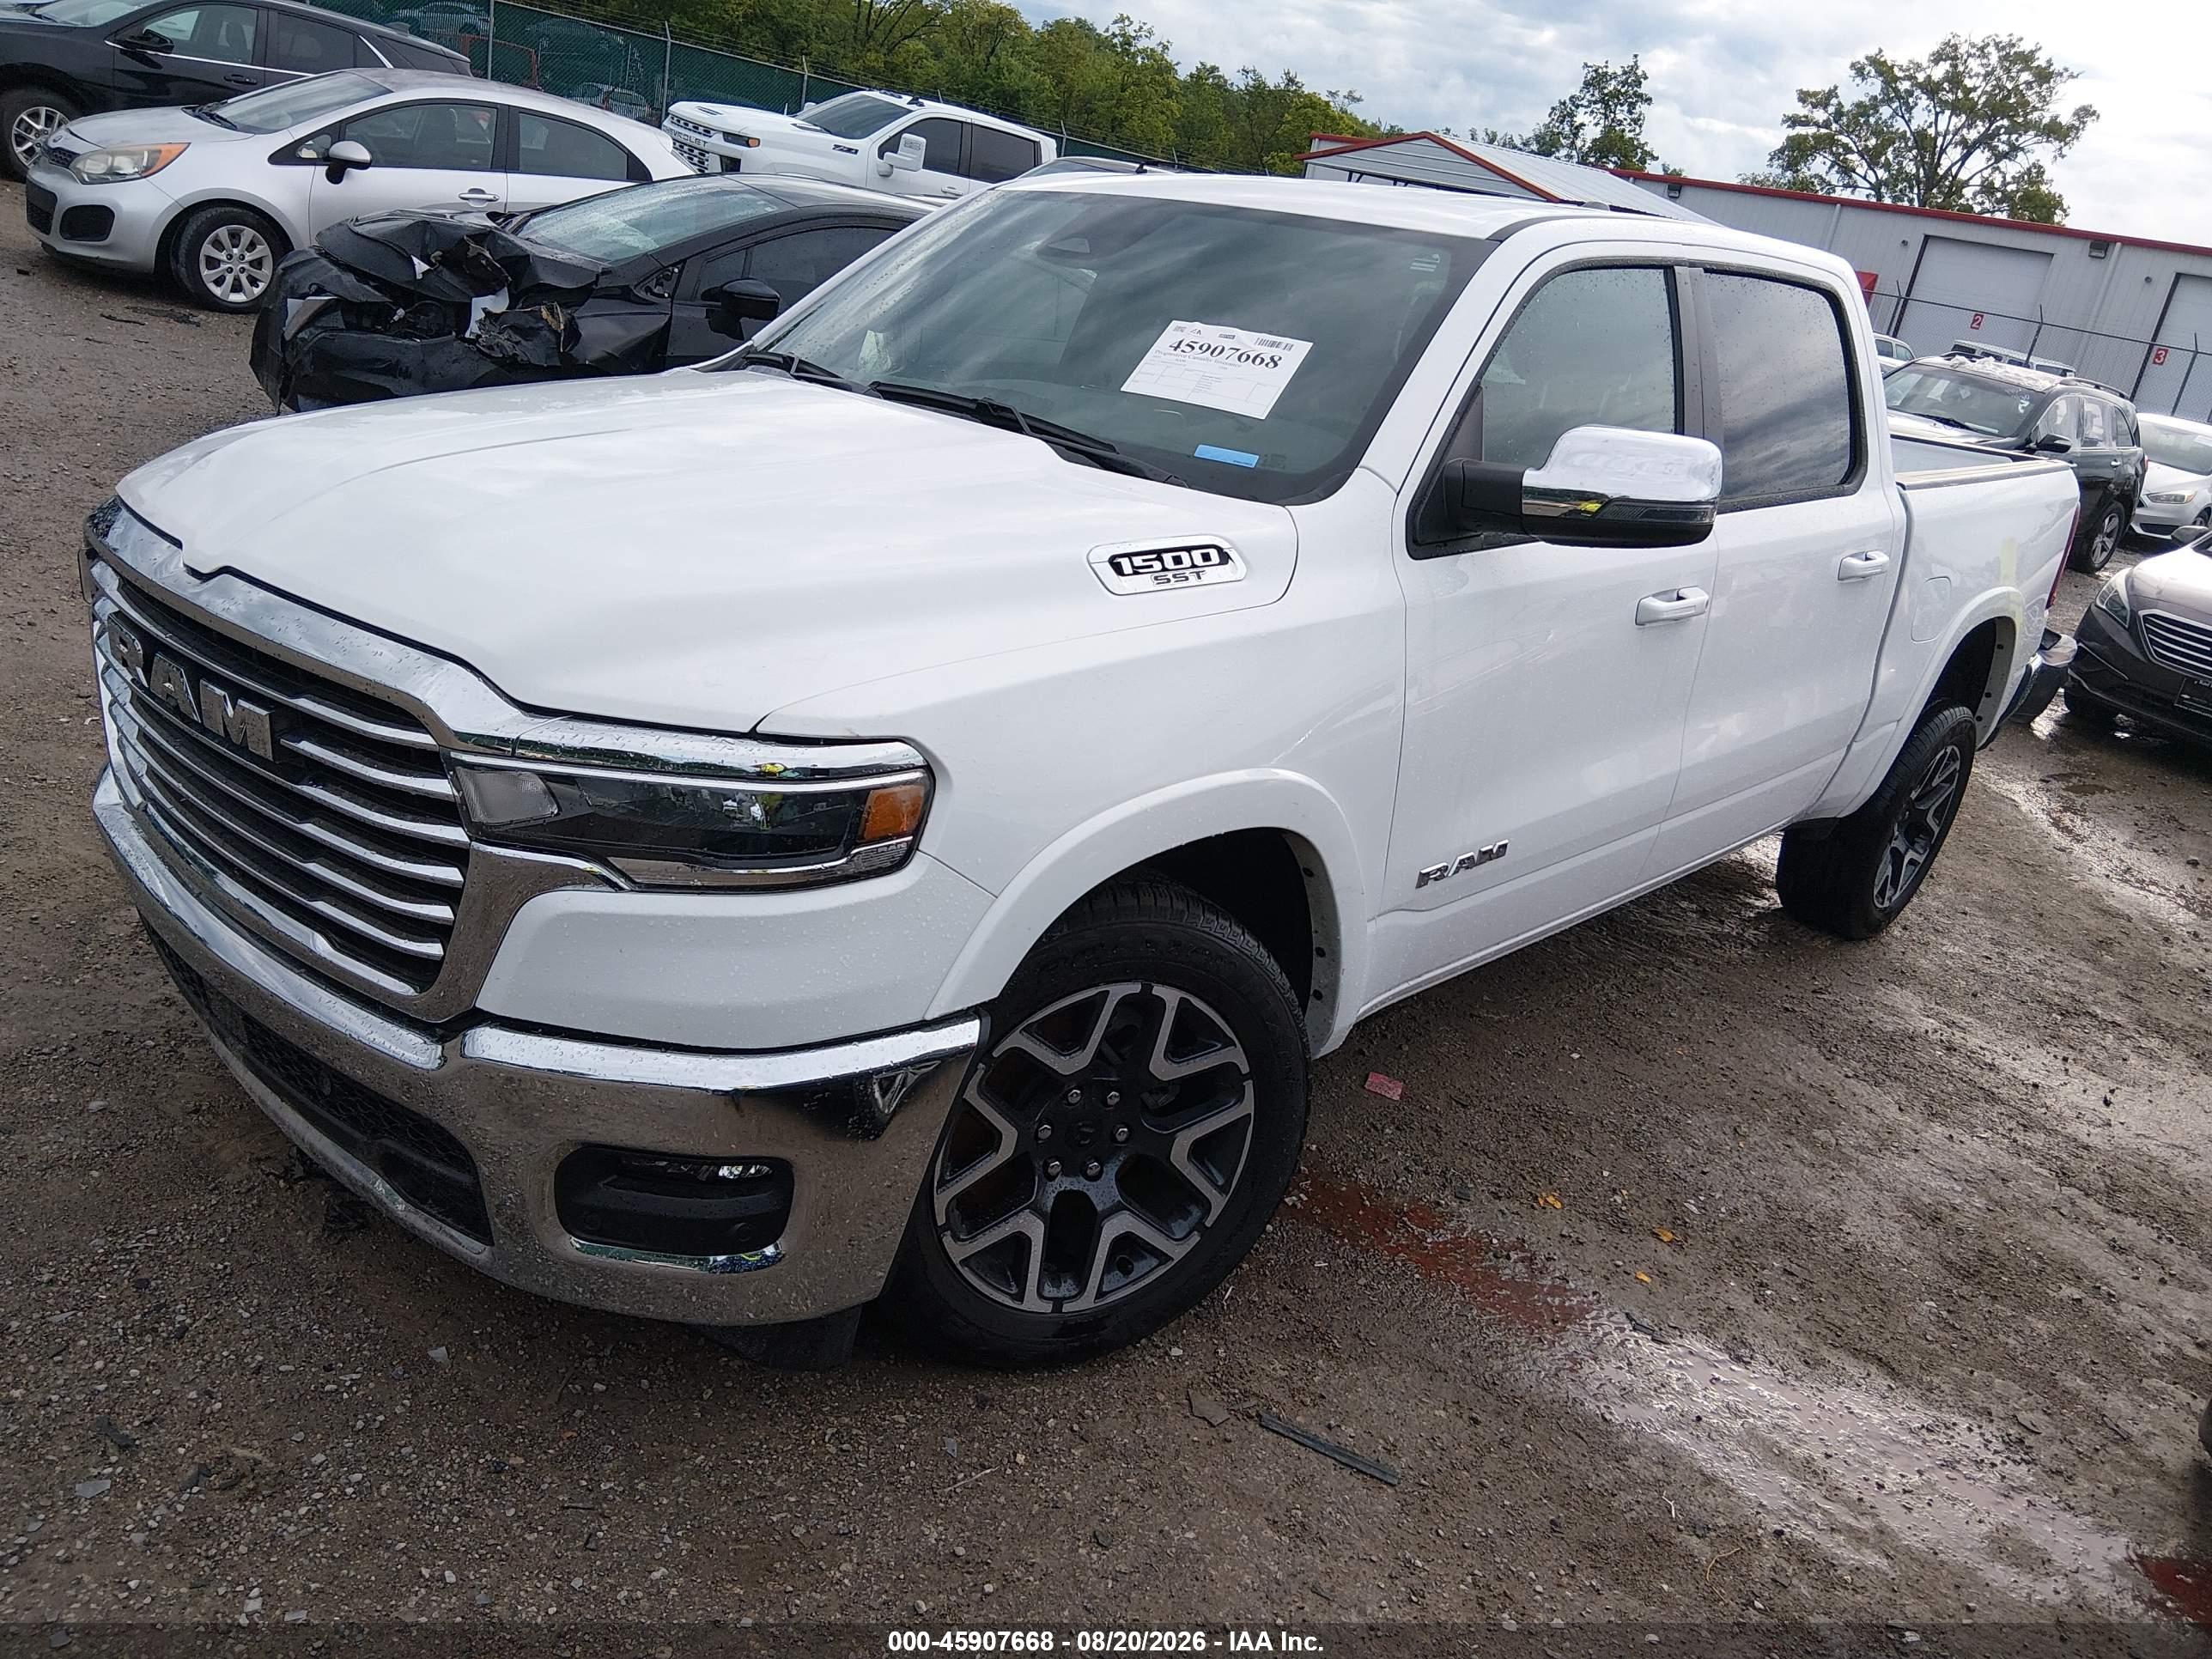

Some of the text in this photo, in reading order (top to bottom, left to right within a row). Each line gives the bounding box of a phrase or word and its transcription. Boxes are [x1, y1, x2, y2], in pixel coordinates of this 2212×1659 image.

[1971, 315, 1982, 328] 2
[1169, 337, 1283, 369] 45907668
[2154, 350, 2166, 364] 3
[1113, 547, 1220, 575] 1500
[1153, 570, 1207, 585] SST
[107, 611, 275, 763] RAM
[1415, 838, 1510, 890] RAM
